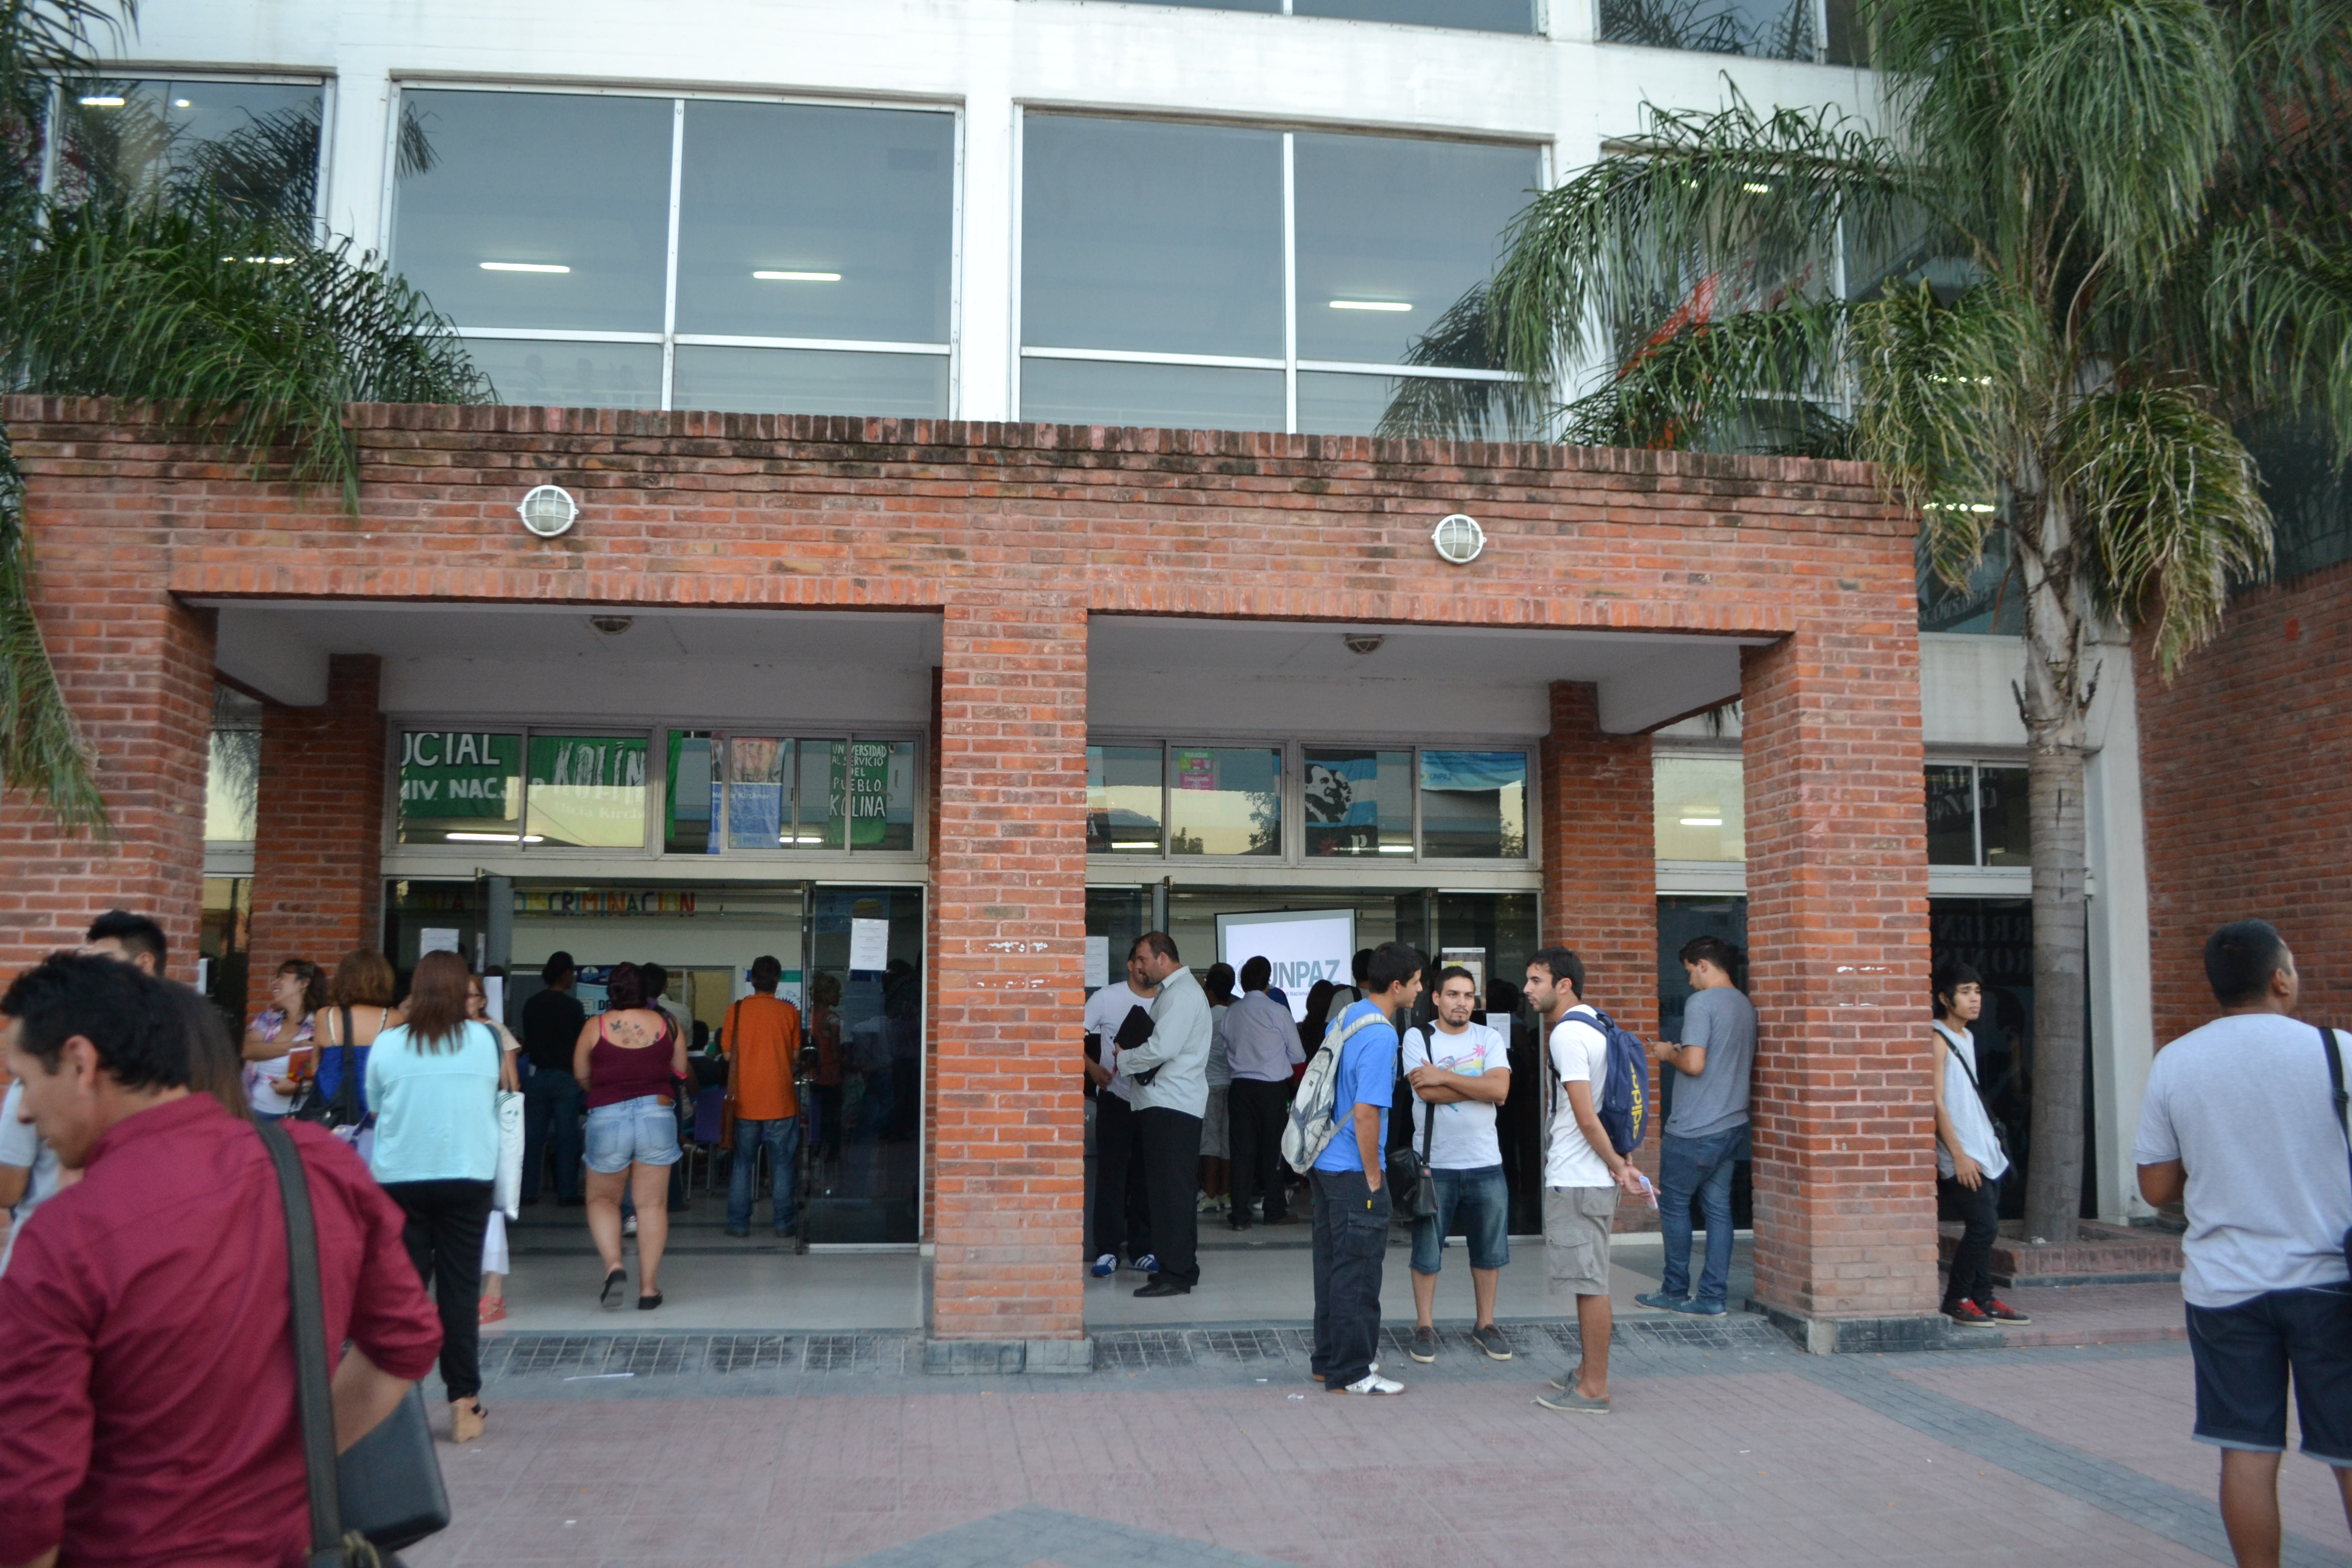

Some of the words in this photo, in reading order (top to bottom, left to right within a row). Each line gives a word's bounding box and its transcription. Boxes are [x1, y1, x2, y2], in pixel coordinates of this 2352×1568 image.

[831, 755, 841, 765] AL
[1430, 772, 1453, 780] UNPAZ
[1351, 834, 1368, 854] P
